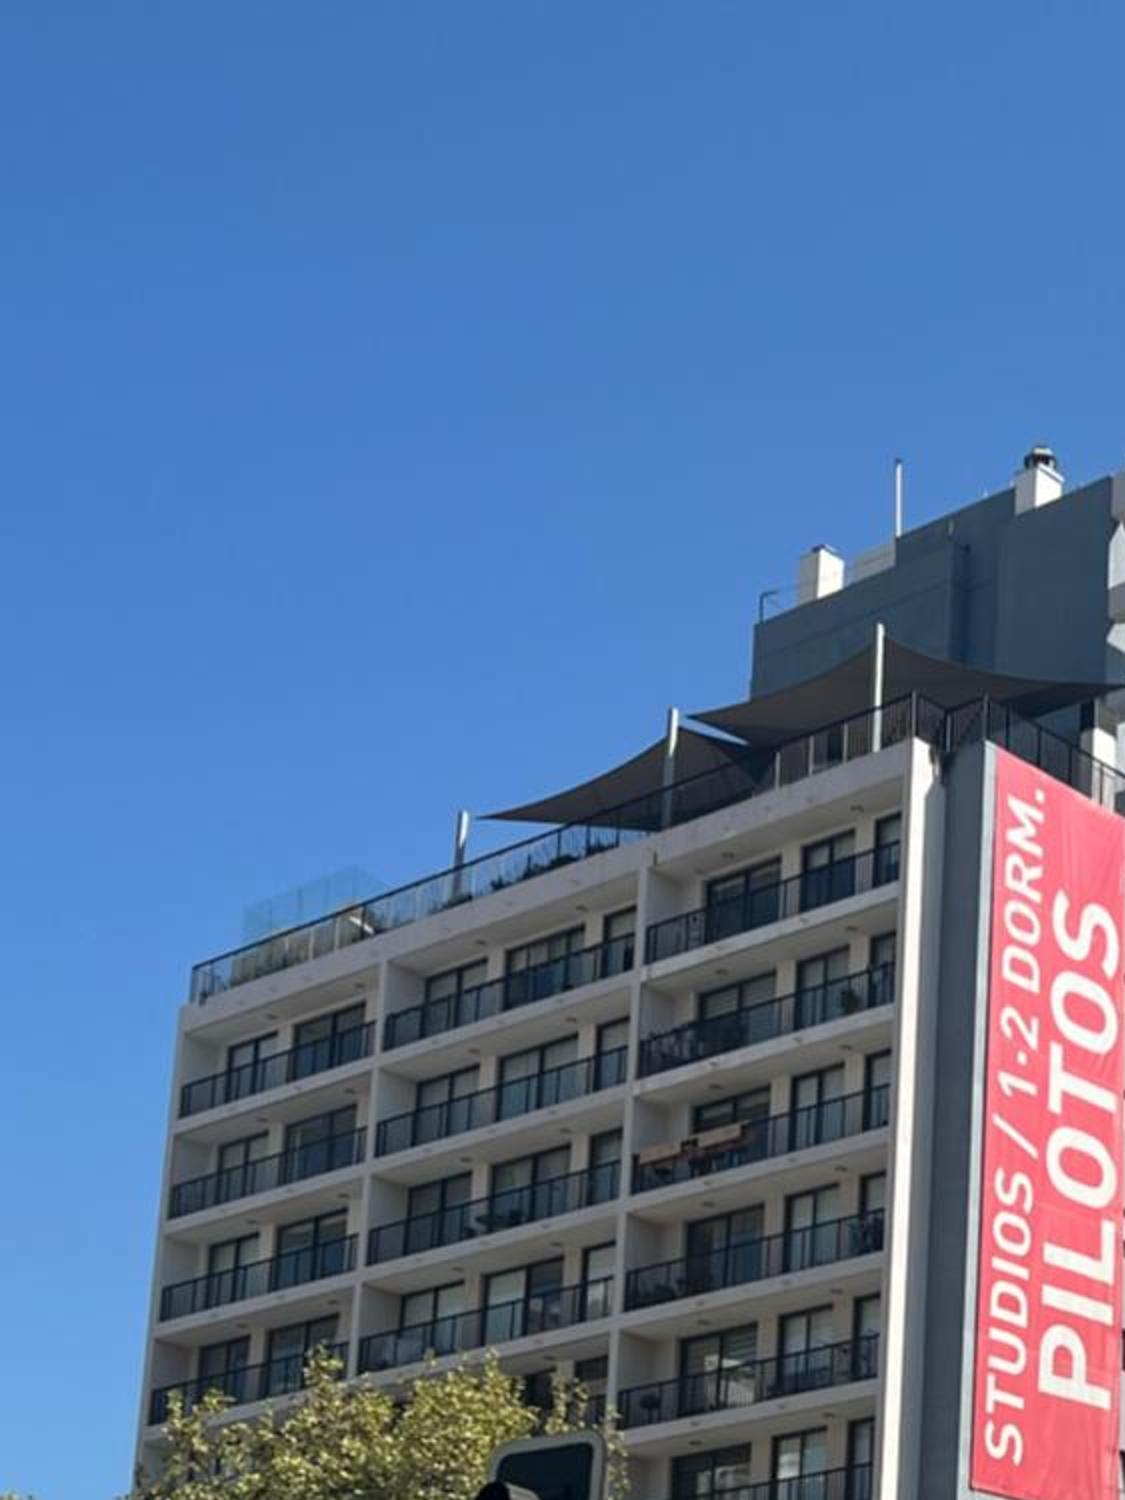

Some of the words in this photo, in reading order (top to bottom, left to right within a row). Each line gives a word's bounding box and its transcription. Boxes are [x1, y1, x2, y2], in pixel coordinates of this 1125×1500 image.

[1001, 788, 1045, 994] DORM.
[993, 1113, 1039, 1160] /
[1037, 889, 1120, 1411] PILOTOS
[984, 1167, 1034, 1467] STUDIOS
